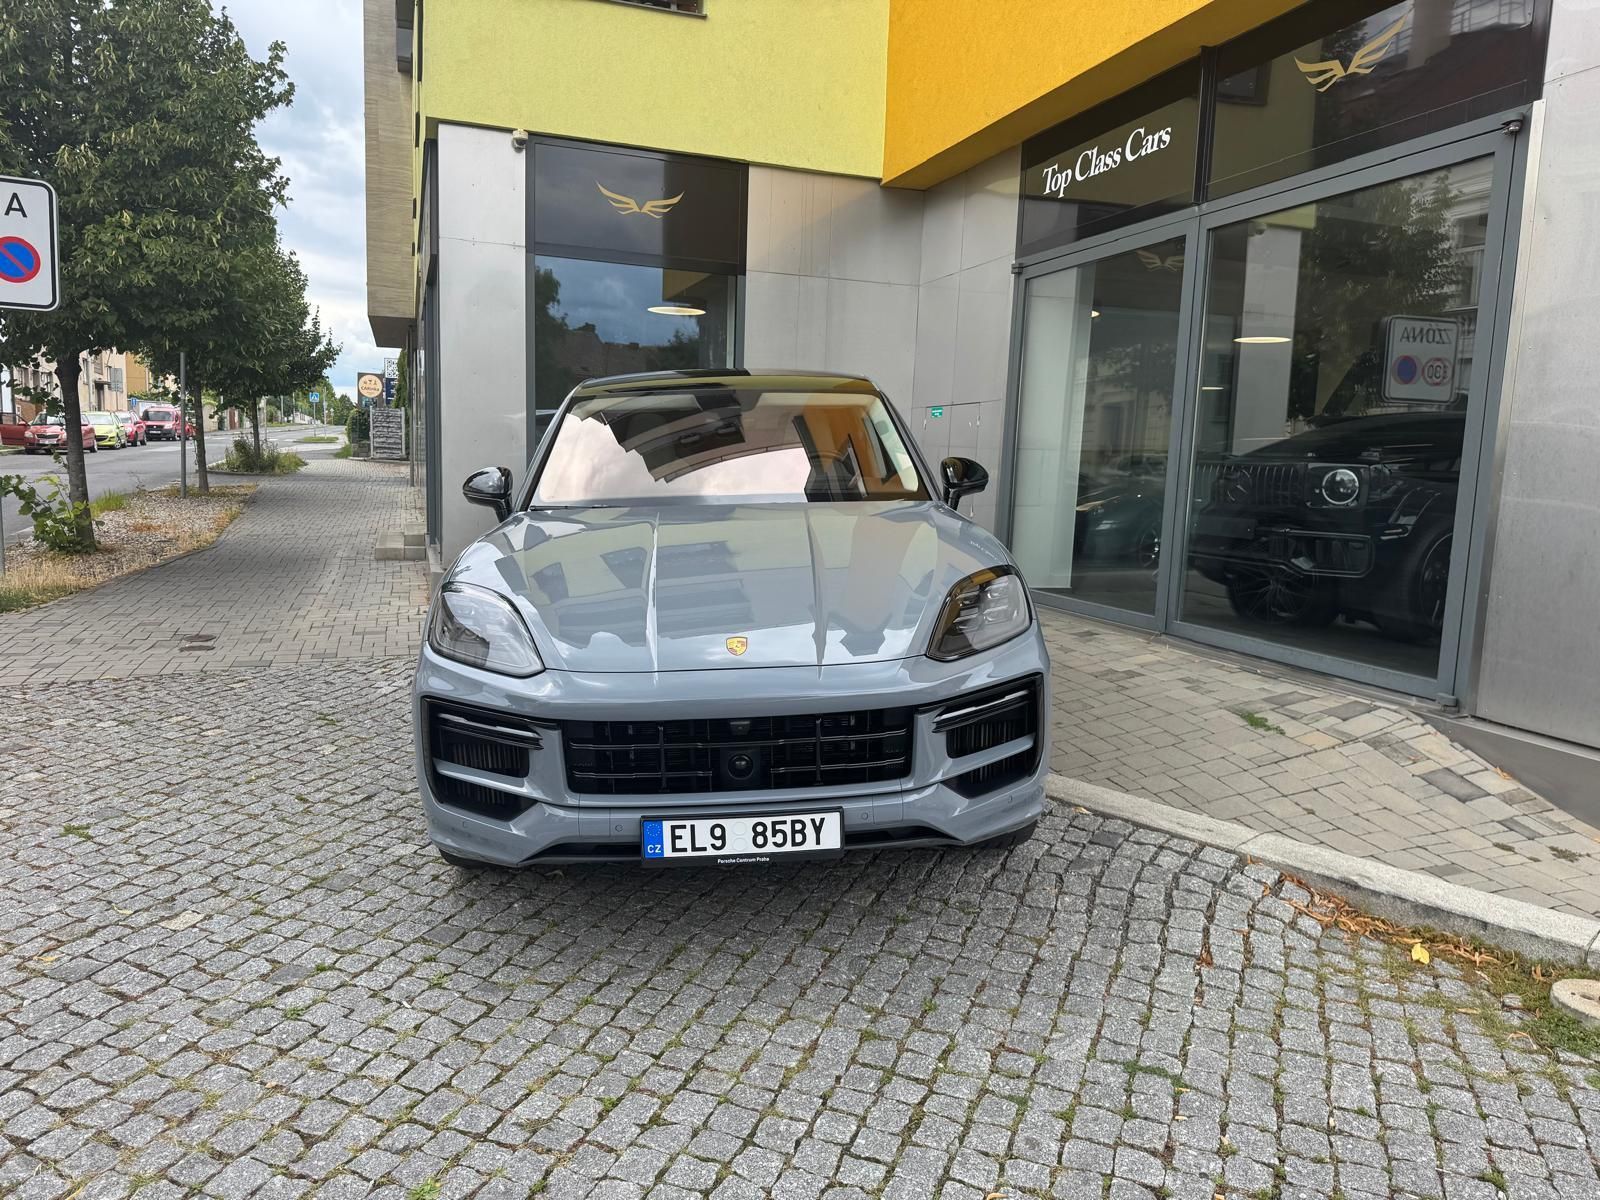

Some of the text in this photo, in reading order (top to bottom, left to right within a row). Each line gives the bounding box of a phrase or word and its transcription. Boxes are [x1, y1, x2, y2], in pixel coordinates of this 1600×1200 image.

[1042, 126, 1172, 198] Top Class Cars
[4, 192, 28, 218] A
[647, 844, 662, 854] CZ
[670, 817, 826, 853] EL9 85BY
